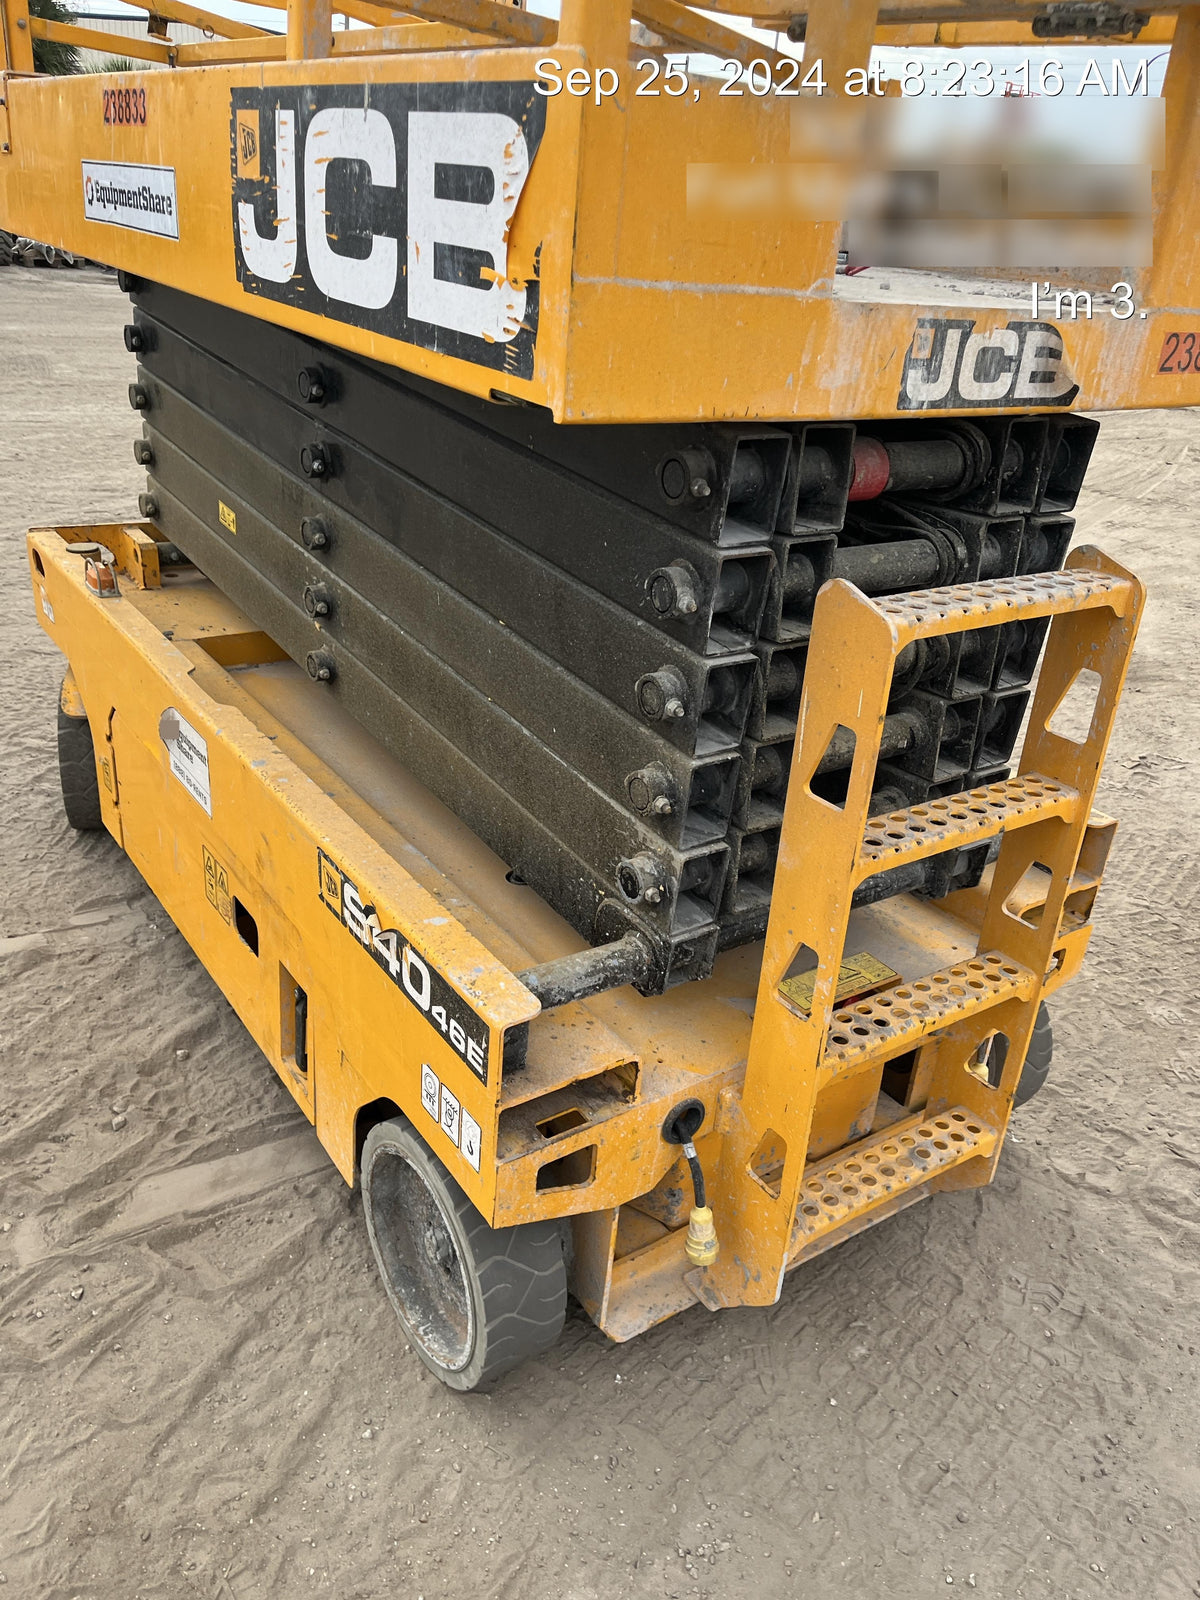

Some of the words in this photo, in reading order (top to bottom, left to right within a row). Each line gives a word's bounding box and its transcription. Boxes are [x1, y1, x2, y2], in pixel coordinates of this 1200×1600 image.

[103, 88, 147, 124] 238833
[94, 181, 173, 216] EquipmentShare
[238, 107, 529, 343] JCB
[906, 328, 1075, 400] JCB
